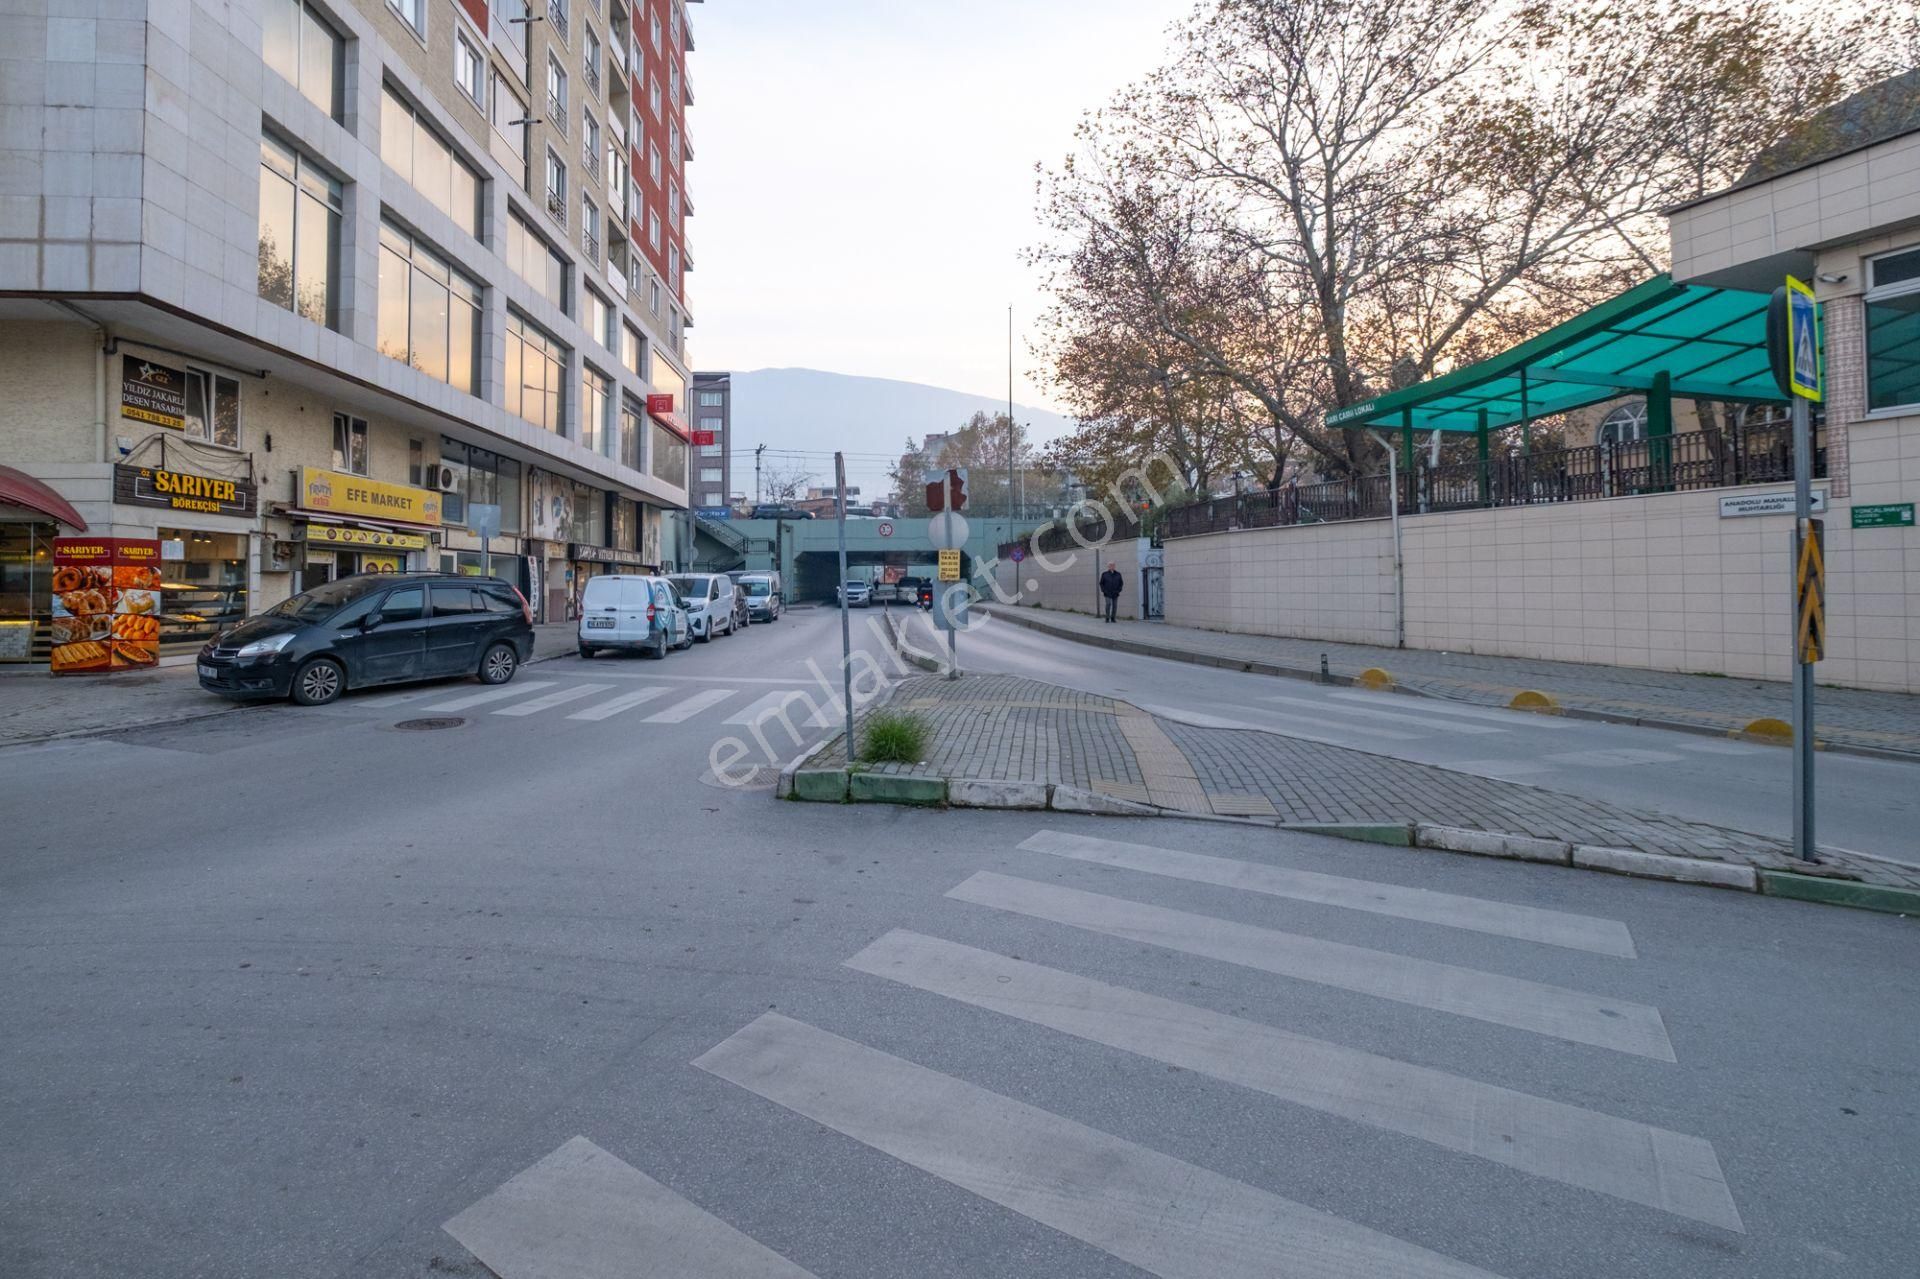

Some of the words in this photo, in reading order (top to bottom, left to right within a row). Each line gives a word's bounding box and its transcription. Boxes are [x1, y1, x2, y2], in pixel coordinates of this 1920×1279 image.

[124, 382, 151, 397] YILDIZ
[123, 393, 150, 407] DESEN
[155, 470, 236, 501] SARIYER
[172, 497, 220, 513] BÖREKÇİSİ
[346, 487, 368, 503] EFE
[371, 491, 413, 511] MARKET
[1724, 499, 1761, 507] ANADOLU
[1763, 496, 1796, 504] MAHALL
[1738, 504, 1785, 512] MUHTARLIĞI
[62, 546, 105, 556] SARIYER
[123, 547, 154, 556] SARIYER
